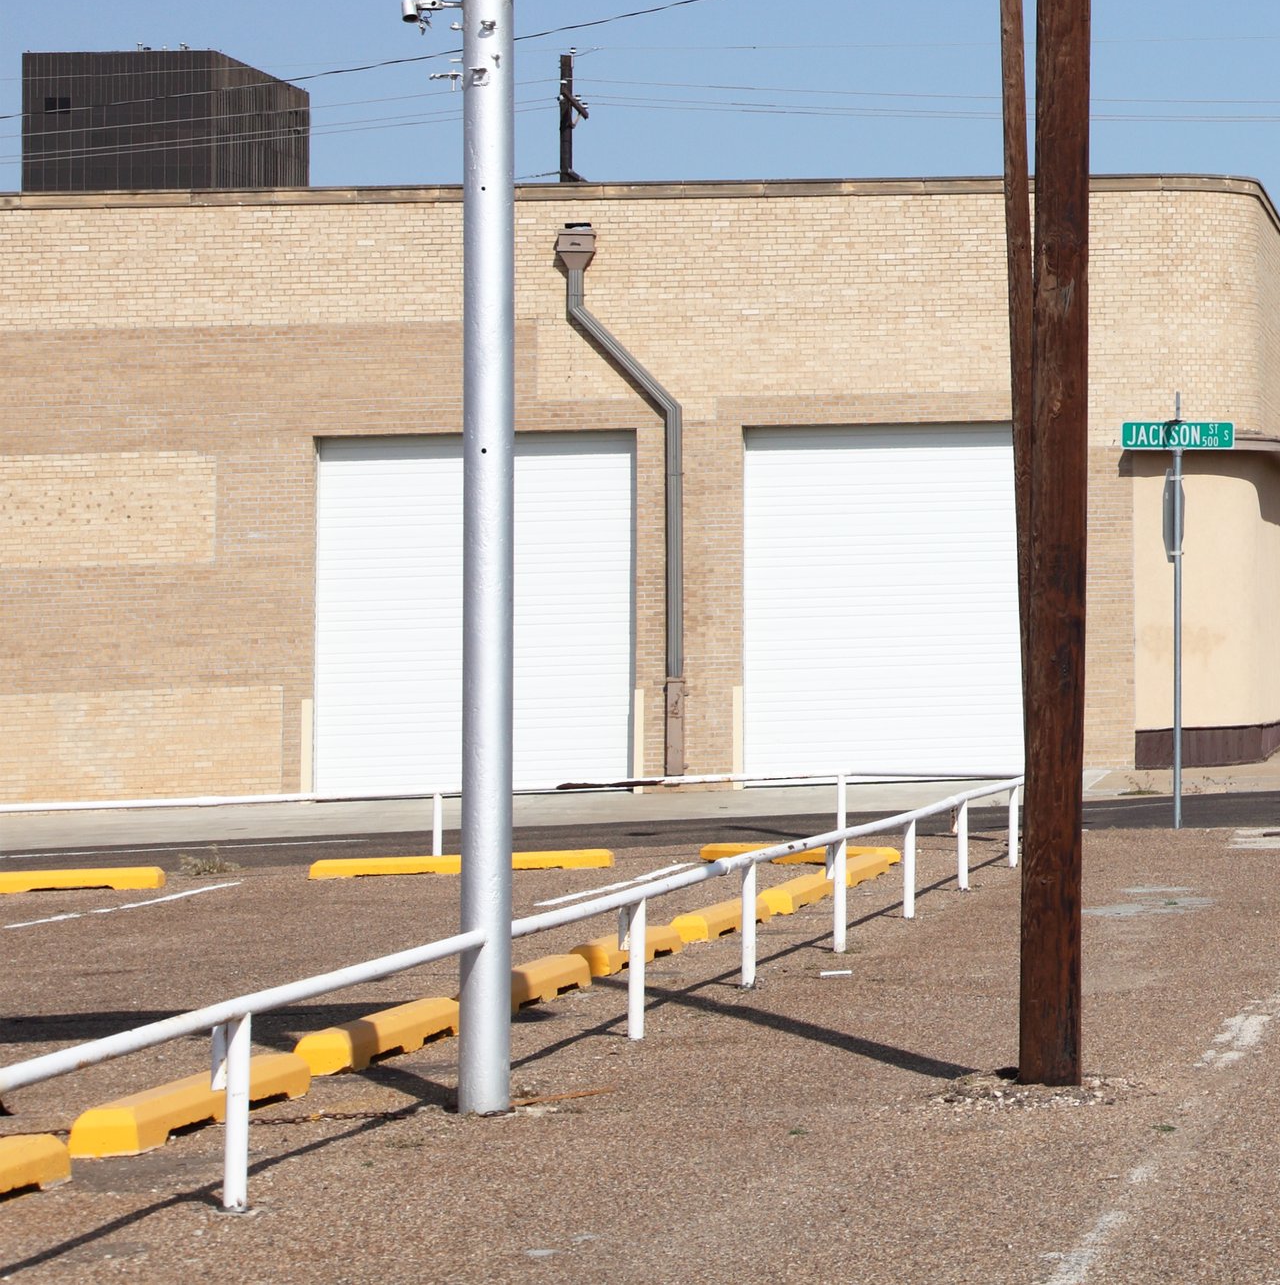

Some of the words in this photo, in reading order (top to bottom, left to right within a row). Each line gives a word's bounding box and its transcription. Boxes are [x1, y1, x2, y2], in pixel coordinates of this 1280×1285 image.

[1126, 425, 1200, 446] JACKSON
[1208, 424, 1219, 435] ST
[1223, 430, 1229, 441] S
[1202, 436, 1219, 447] 500
